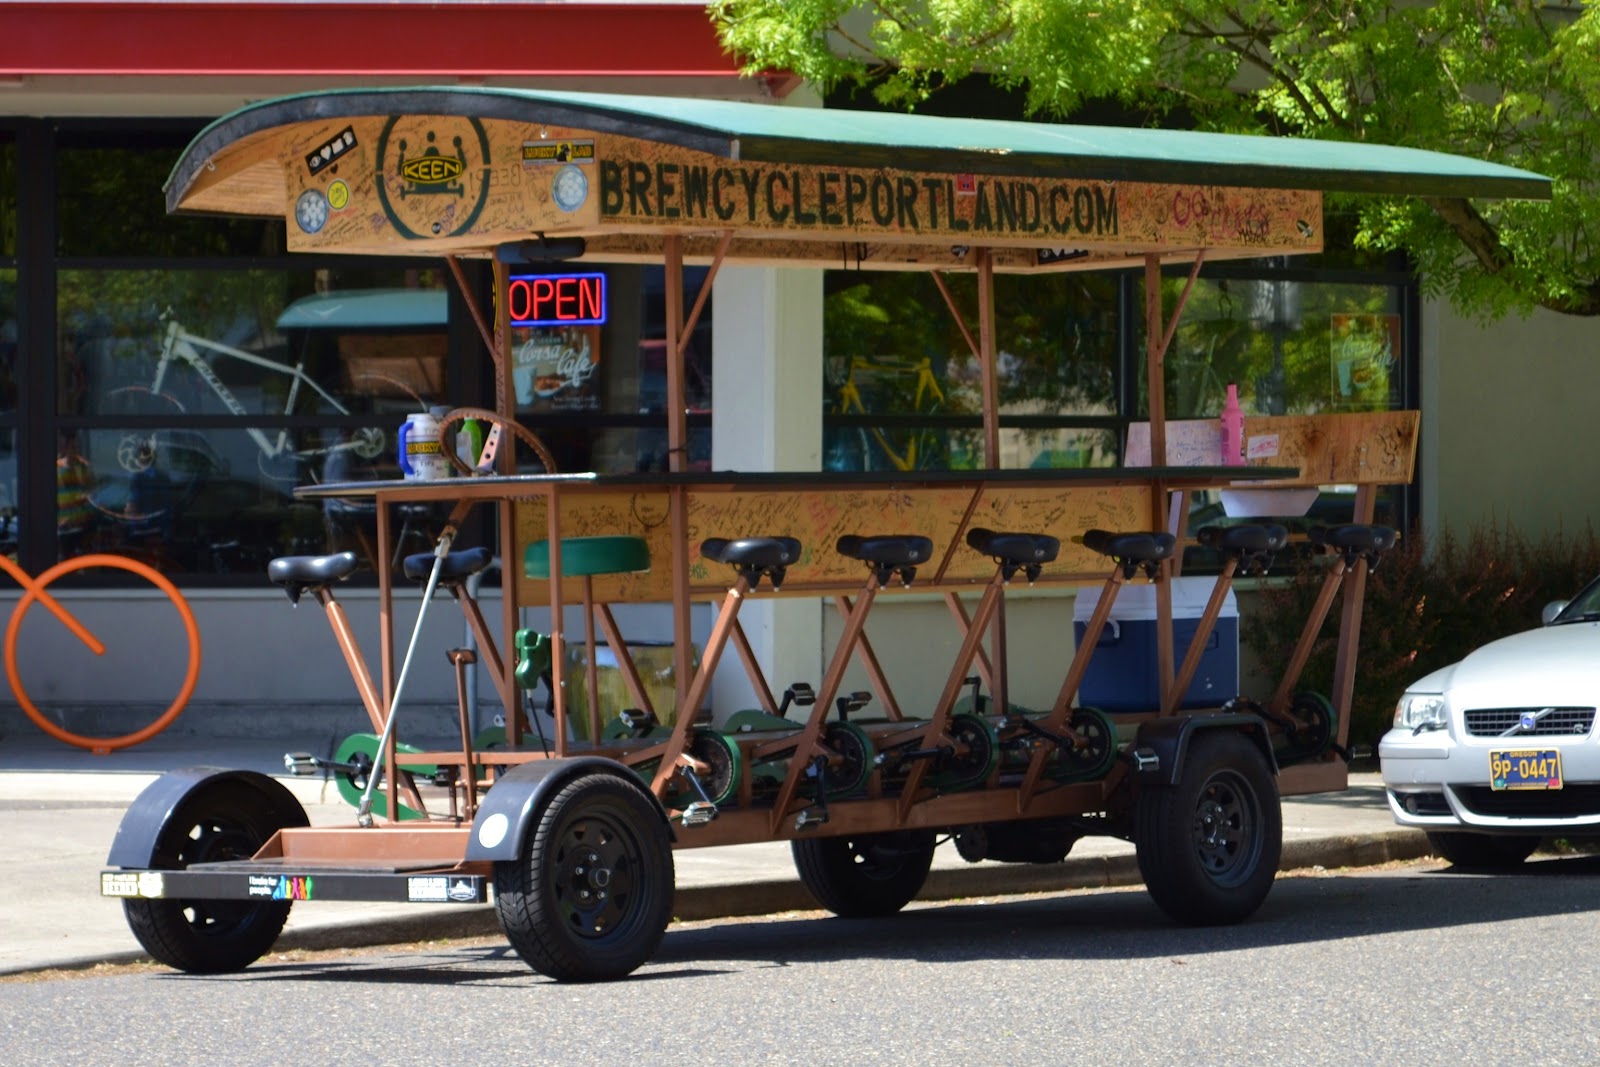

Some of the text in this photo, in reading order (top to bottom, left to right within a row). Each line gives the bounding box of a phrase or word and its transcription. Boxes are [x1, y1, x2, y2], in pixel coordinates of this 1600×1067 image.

[573, 146, 592, 157] LAB
[404, 160, 459, 180] KEEN
[600, 161, 1119, 236] BREWCYCLEPORTLAND.COM
[508, 278, 601, 321] OPEN
[519, 338, 562, 365] Corsa
[1492, 759, 1557, 779] 9P-0447
